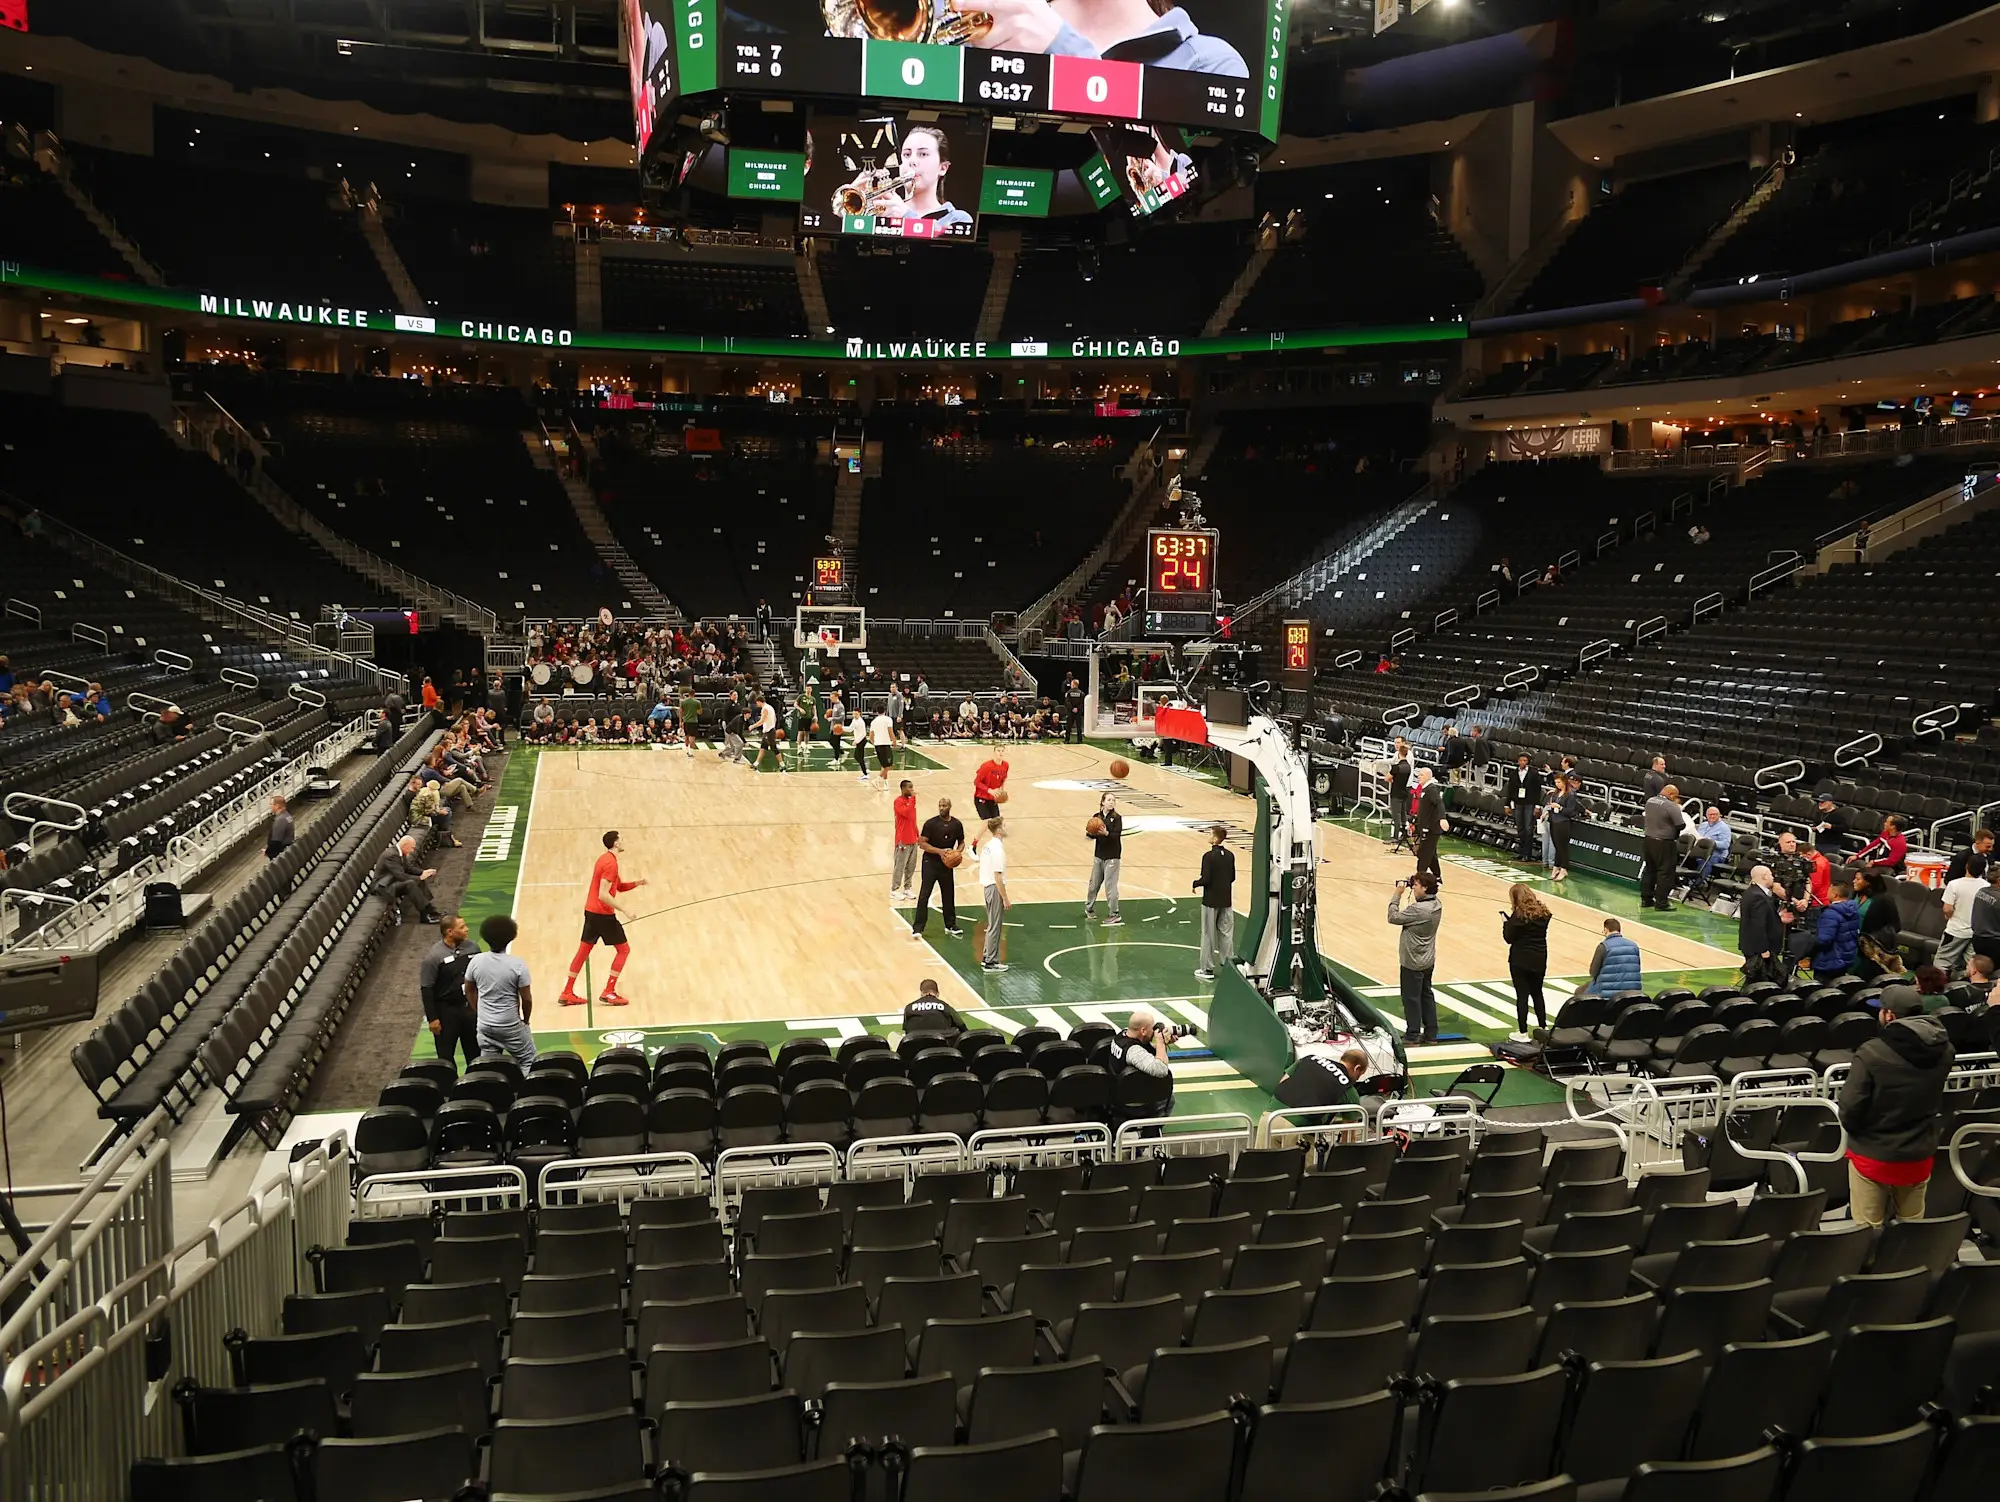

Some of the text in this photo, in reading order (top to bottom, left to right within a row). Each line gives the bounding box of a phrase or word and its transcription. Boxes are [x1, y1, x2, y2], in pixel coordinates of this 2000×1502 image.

[688, 0, 703, 49] GO
[736, 45, 782, 60] TOL 7
[736, 62, 782, 77] FLS 0
[901, 58, 925, 86] 0
[990, 56, 1026, 75] PrG
[979, 81, 1033, 102] 63:37
[1086, 76, 1108, 102] 0
[1207, 86, 1246, 102] TOL 7
[1234, 104, 1245, 117] 0
[745, 162, 787, 170] MILWAUKEE
[996, 179, 1036, 188] MILWAUKEE
[998, 199, 1028, 207] CHICAGO
[200, 294, 572, 346] MILWAUKEE VS CHICAGO
[846, 340, 1180, 358] MILWAUKEE VS CHICAGO
[1572, 427, 1600, 445] FEAR
[1156, 537, 1207, 557] 63:37
[817, 560, 841, 570] 63:37
[1161, 558, 1200, 589] 24
[819, 569, 838, 584] 24
[1288, 627, 1308, 644] 63:37
[1291, 645, 1305, 667] 24
[1569, 838, 1600, 852] MILWAUKEE
[1615, 850, 1641, 862] CHICAGO
[912, 1002, 945, 1011] PHOTO
[1310, 1055, 1349, 1085] PHOTO
